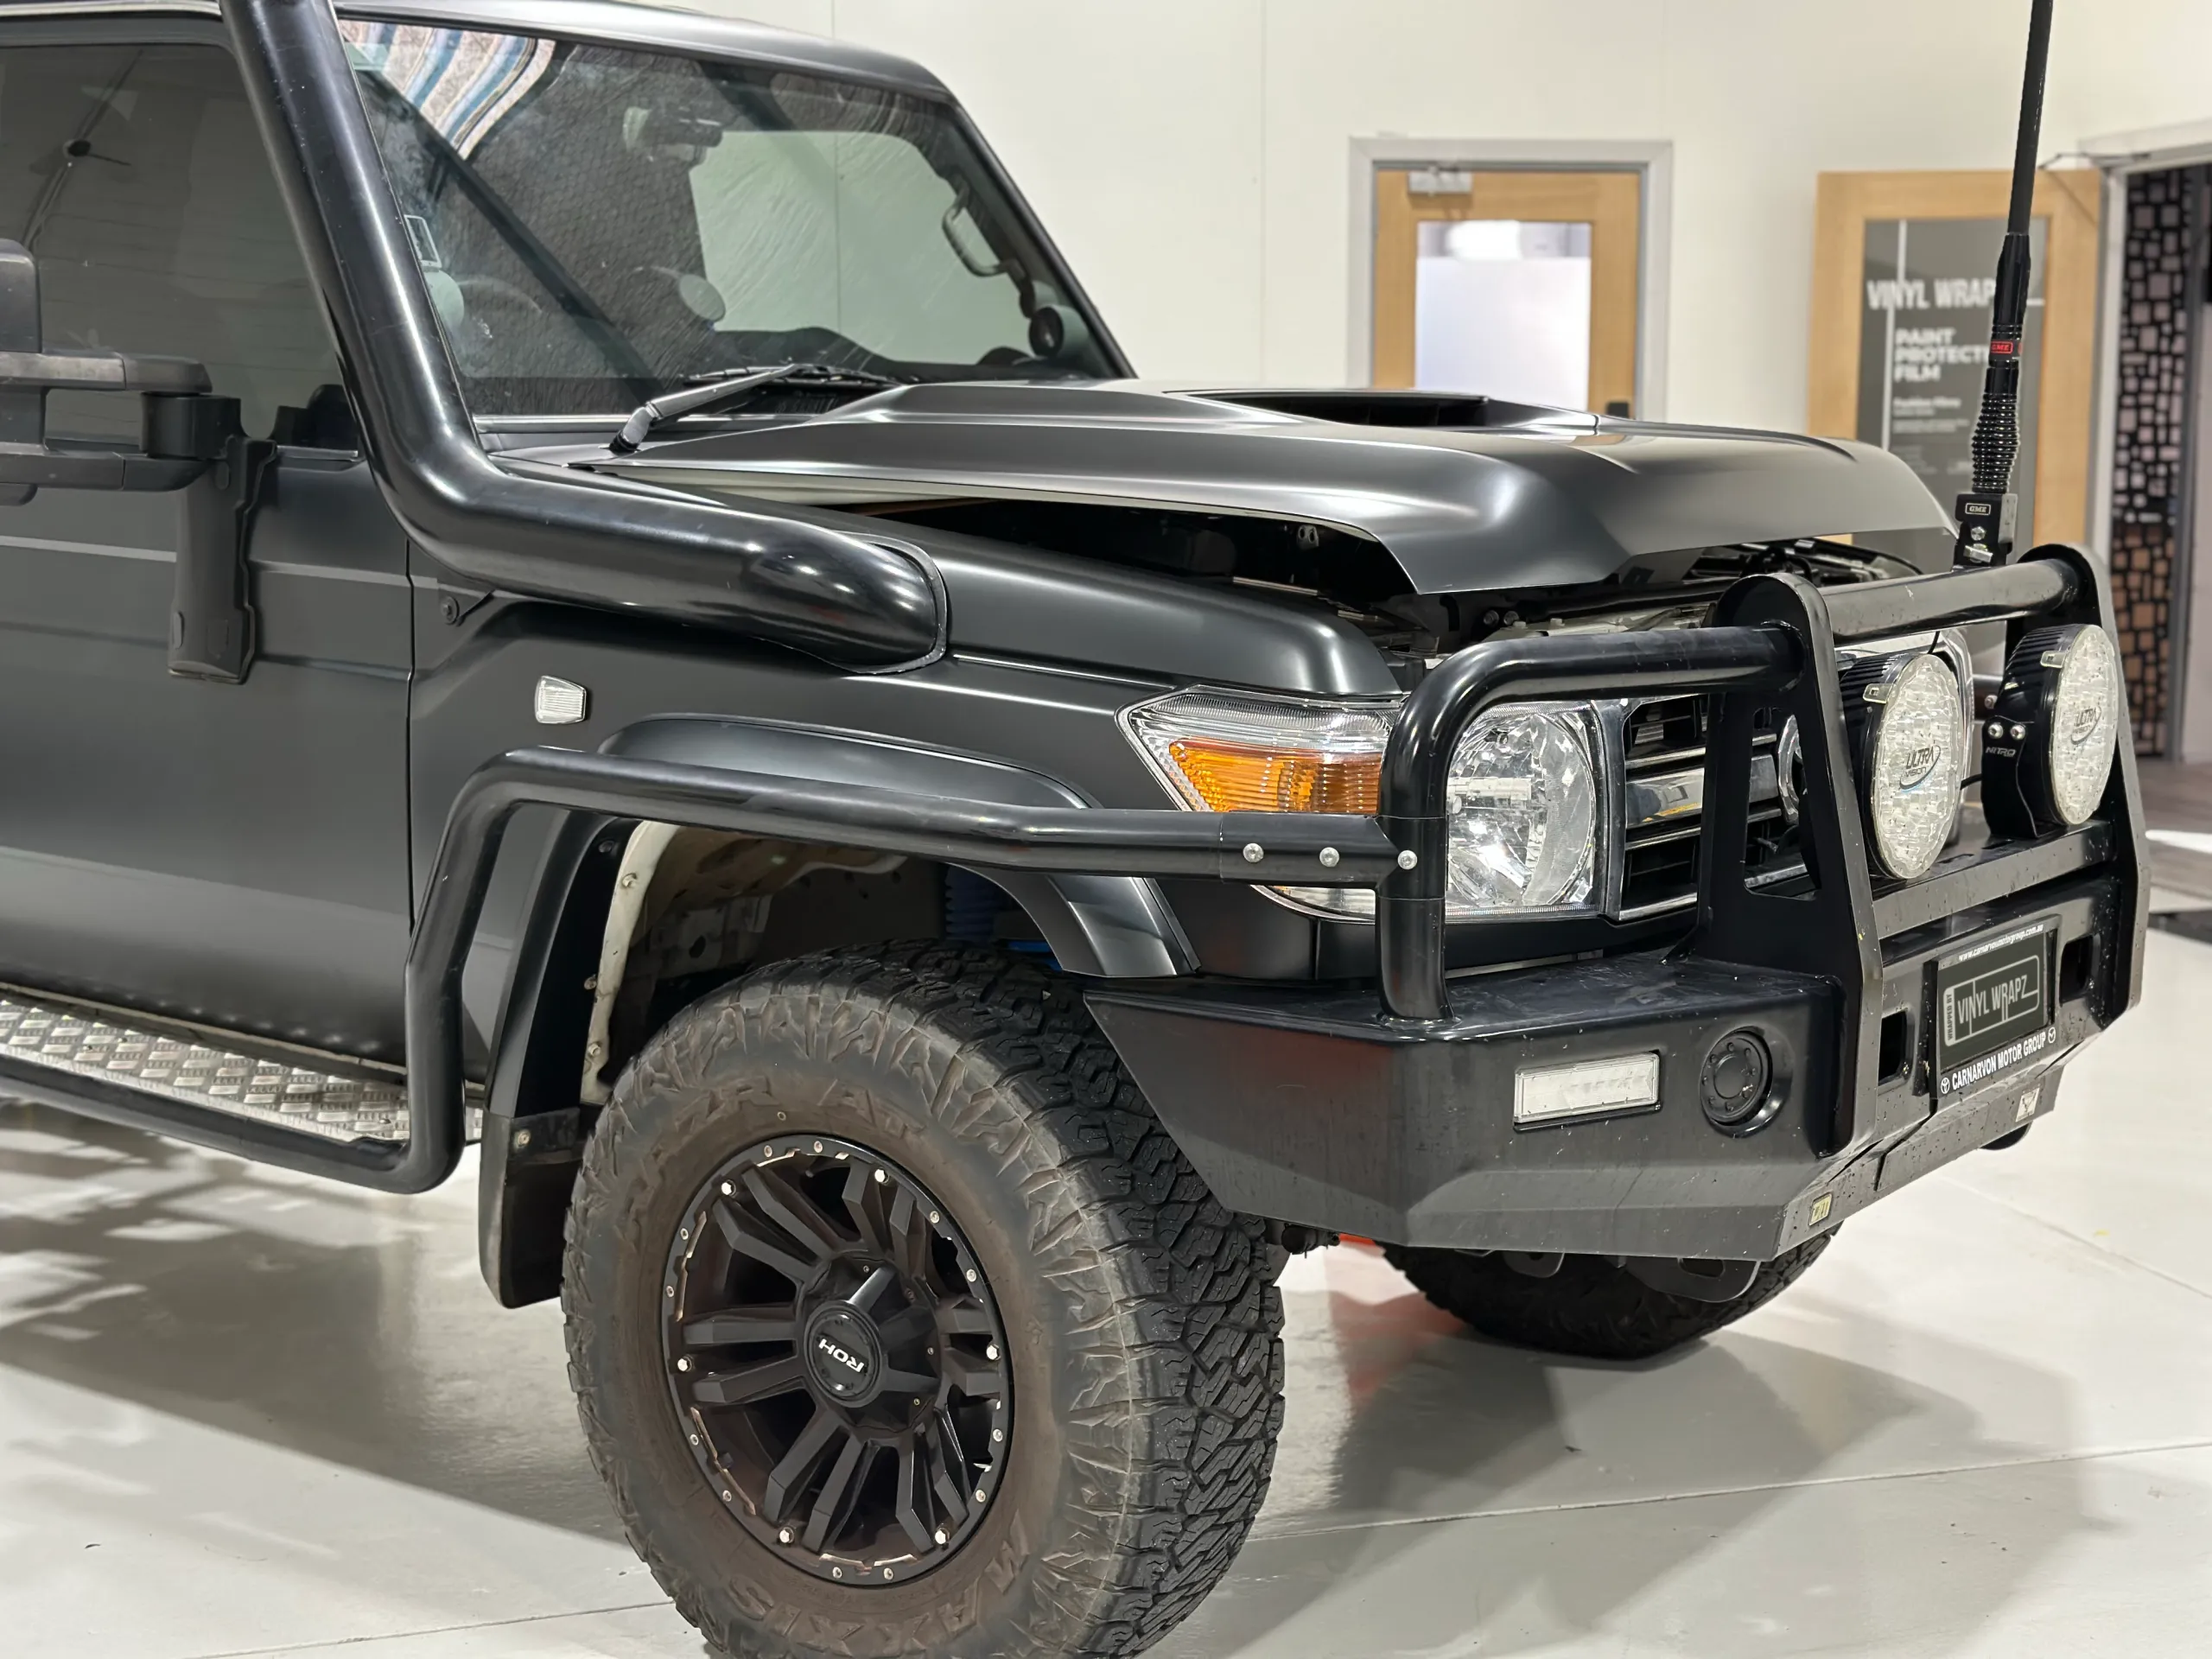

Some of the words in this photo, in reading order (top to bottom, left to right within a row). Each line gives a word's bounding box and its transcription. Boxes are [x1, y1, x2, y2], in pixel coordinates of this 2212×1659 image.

[1867, 279, 1929, 309] VINYL
[1935, 277, 1996, 308] WRAP
[1895, 327, 1955, 345] PAINT
[1895, 346, 1989, 363] PROTECTI
[1894, 364, 1941, 381] FILM
[1906, 747, 1934, 769] ULTRA
[1986, 747, 2016, 756] NITRO
[1957, 988, 1990, 1025] VINYL
[1991, 975, 2028, 1012] WRAPZ
[1952, 1058, 1997, 1090] CARNARVON
[1997, 1046, 2023, 1069] MOTOR
[2023, 1035, 2046, 1056] GROUP
[818, 1338, 865, 1373] ROH
